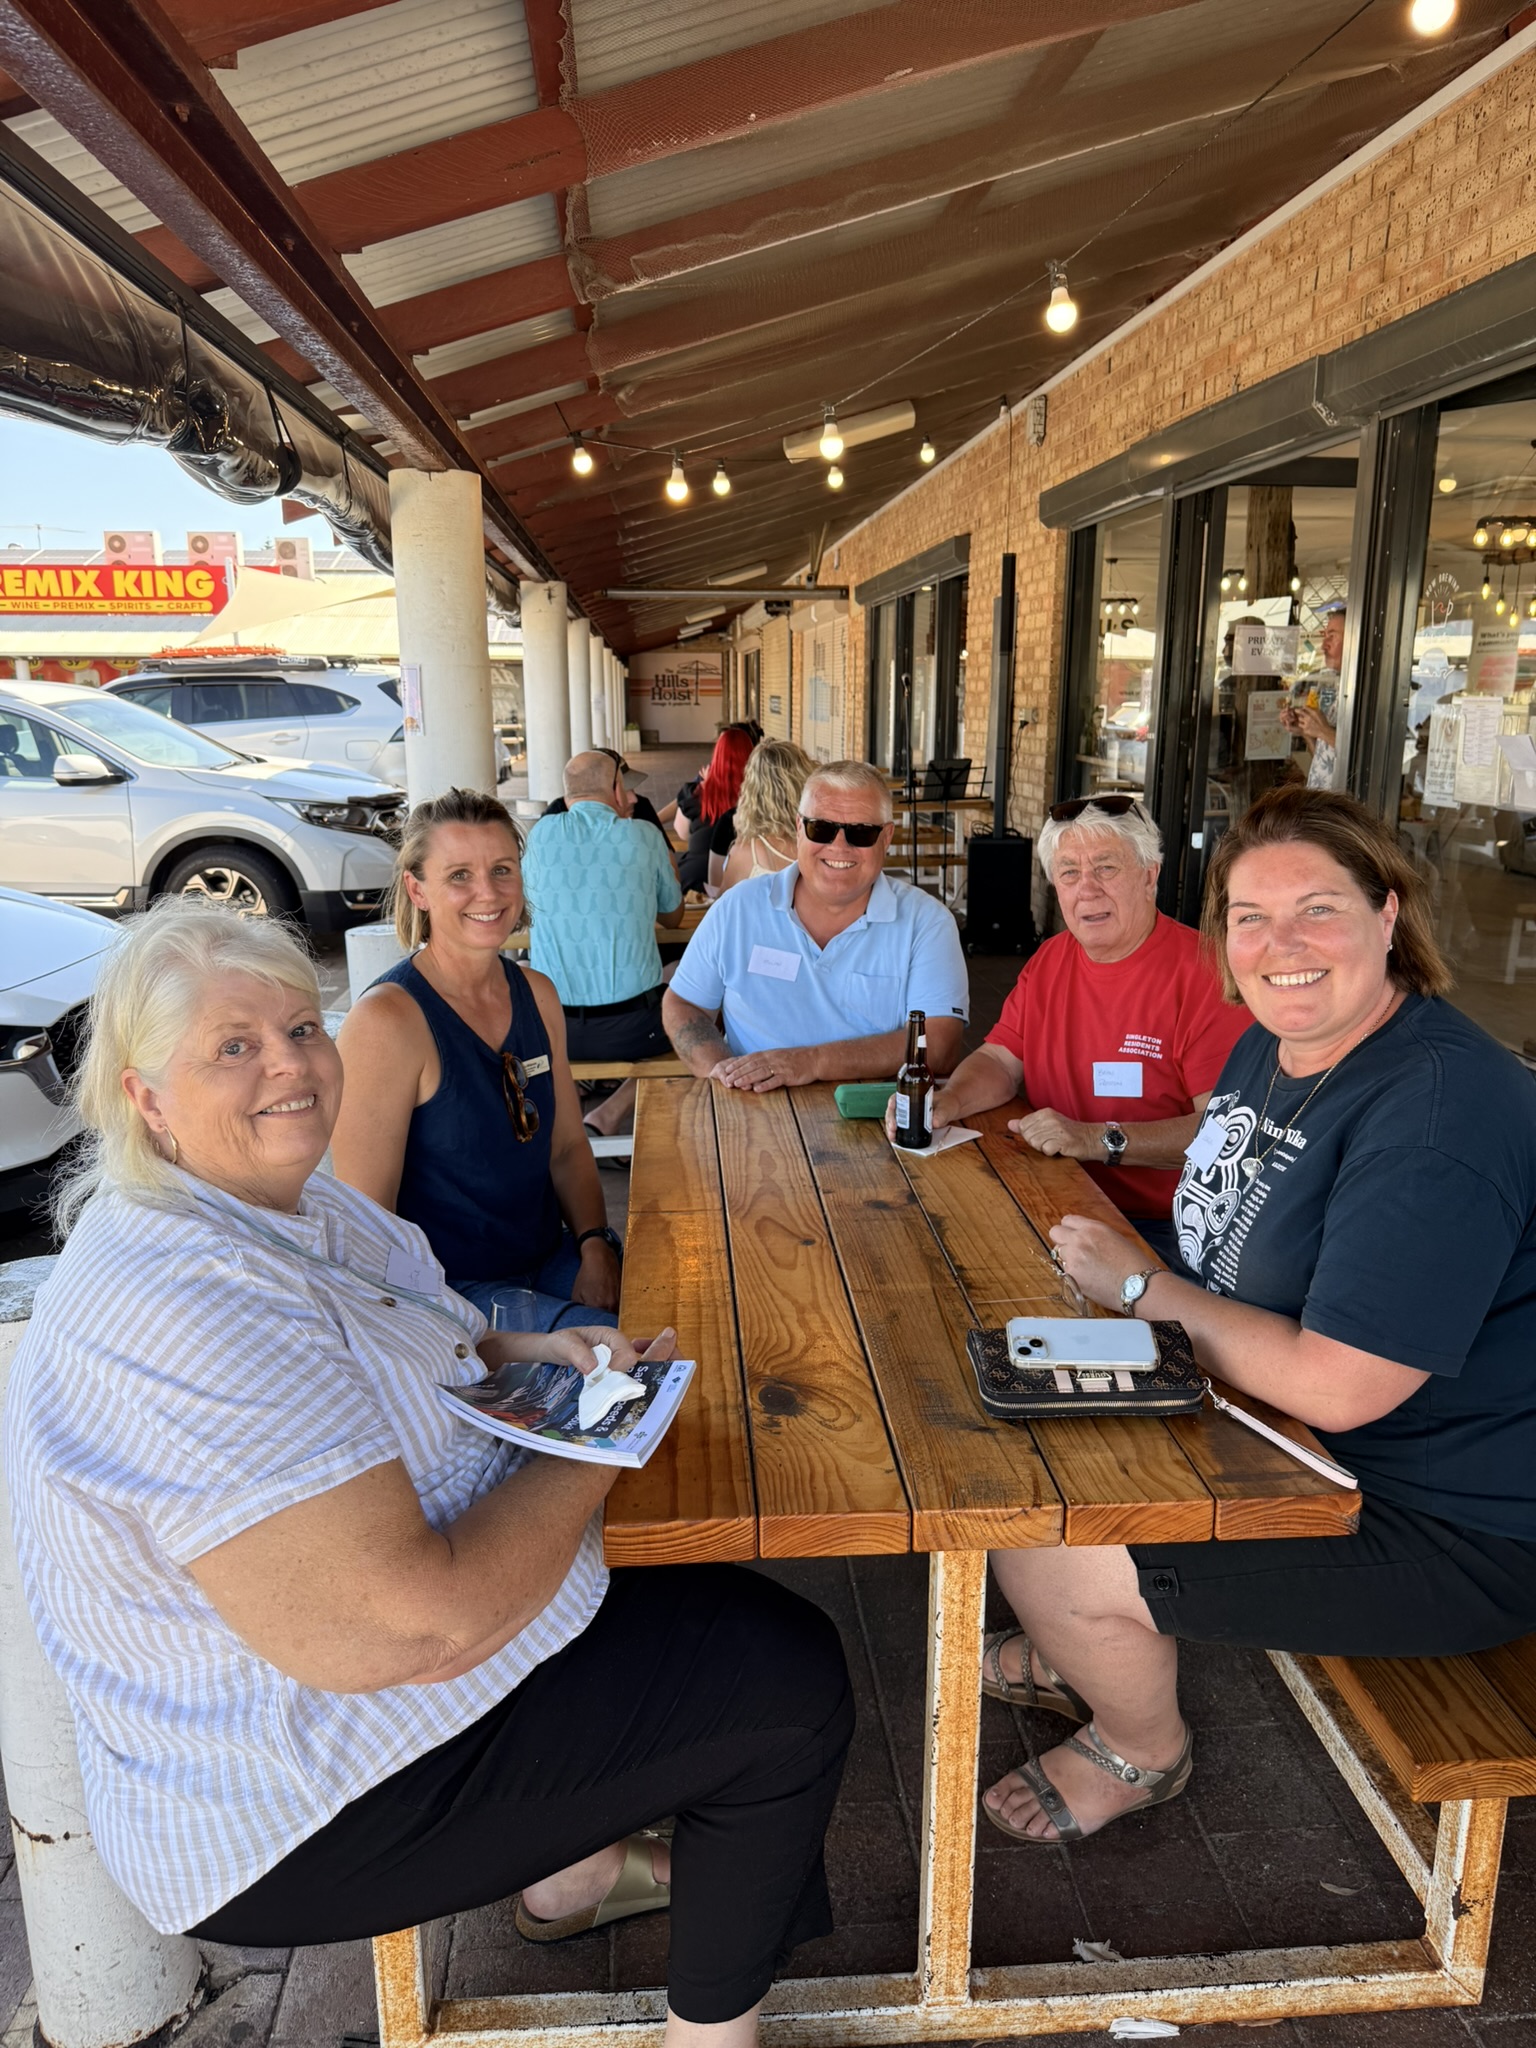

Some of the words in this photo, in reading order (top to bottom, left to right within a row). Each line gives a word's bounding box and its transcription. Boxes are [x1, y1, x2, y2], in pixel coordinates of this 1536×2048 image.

[112, 569, 216, 598] KING
[11, 601, 41, 610] WINE
[53, 601, 95, 610] PREMIX
[109, 602, 152, 610] SPIRITS
[167, 602, 204, 610] CRAFT
[1247, 636, 1286, 645] PRIVATE
[1251, 647, 1281, 656] EVENT
[655, 674, 689, 688] Hills
[651, 687, 691, 701] Hoist
[1125, 1033, 1163, 1045] SINGLETON
[1123, 1040, 1161, 1052] RESIDENTS
[1118, 1046, 1164, 1060] ASSOCIATION
